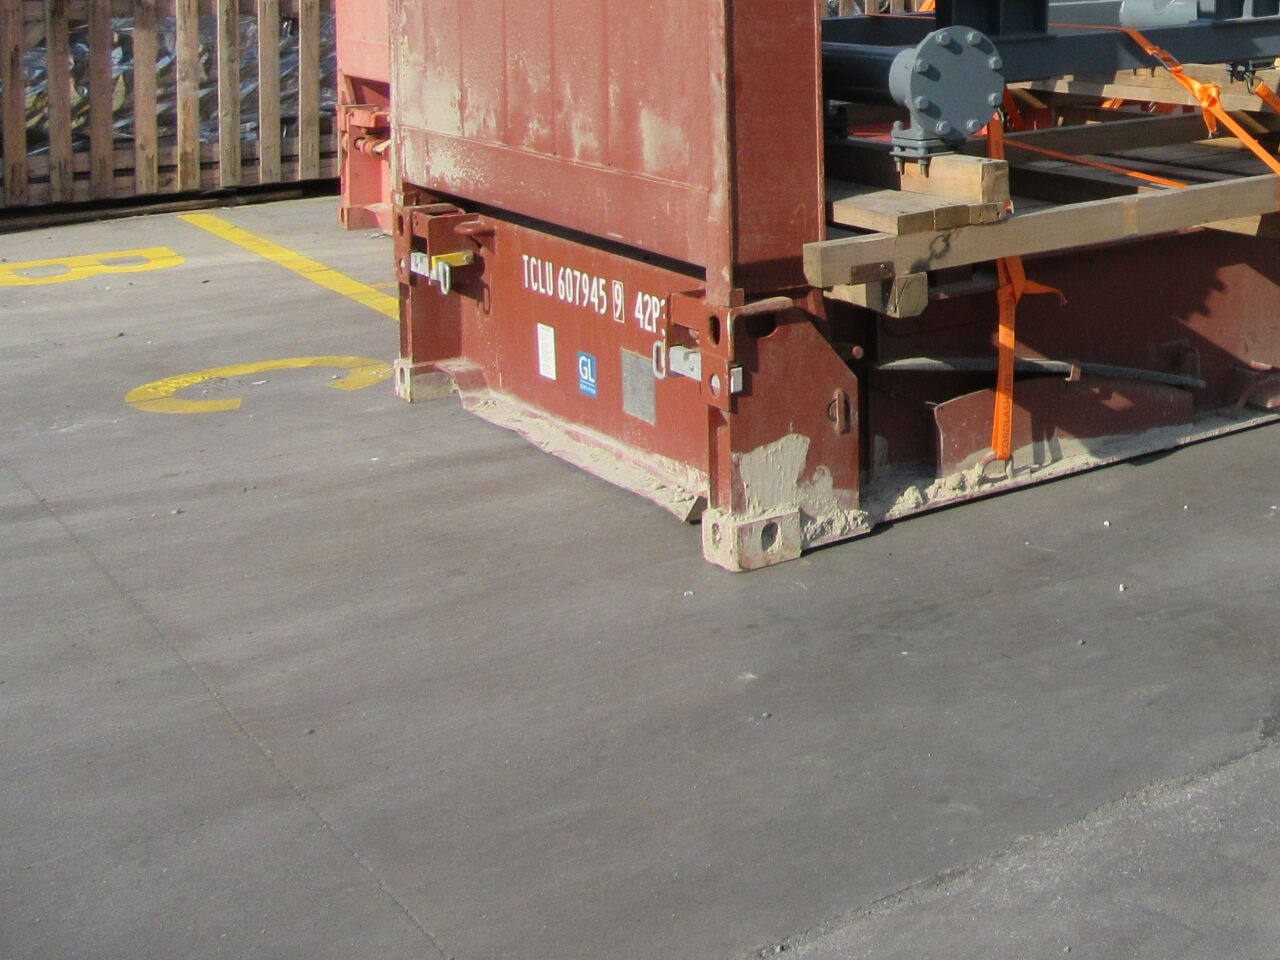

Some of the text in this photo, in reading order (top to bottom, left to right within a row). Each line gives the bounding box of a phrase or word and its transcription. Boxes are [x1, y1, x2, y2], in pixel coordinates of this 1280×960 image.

[522, 254, 554, 297] TCLU
[558, 266, 608, 315] 607945
[613, 281, 623, 321] 9
[578, 355, 596, 383] GL
